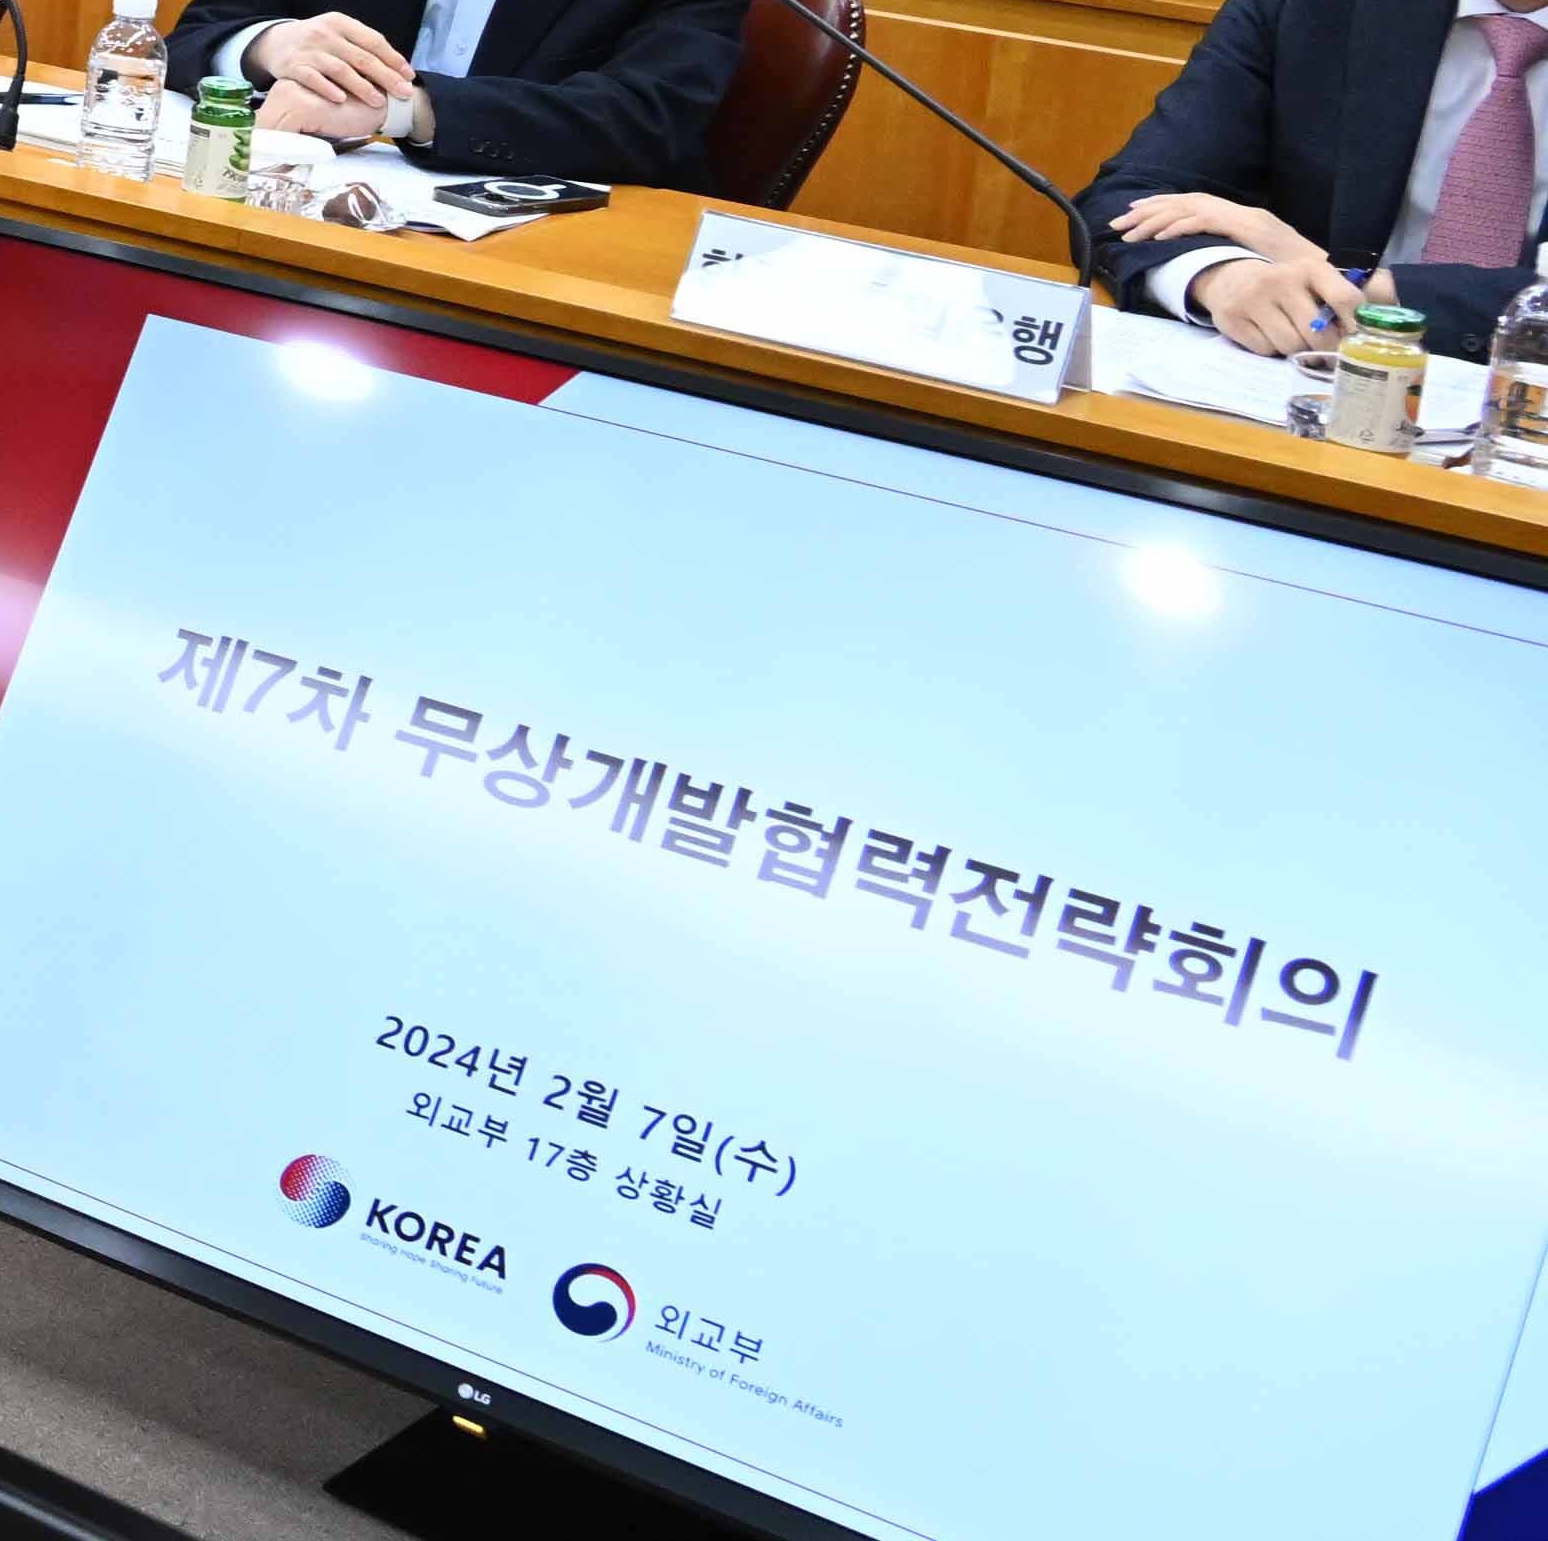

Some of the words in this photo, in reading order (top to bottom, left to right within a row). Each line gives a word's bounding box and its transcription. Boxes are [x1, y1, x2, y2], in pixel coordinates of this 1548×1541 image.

[158, 628, 373, 752] 제7차
[393, 695, 1380, 1063] 무상개발협력전략회의
[375, 1015, 529, 1098] 2024년
[543, 1074, 621, 1129] 2월
[640, 1105, 798, 1198] 7일(수)
[405, 1091, 510, 1149] 외교부
[525, 1136, 599, 1184] 17층
[615, 1165, 724, 1230] 상황실
[365, 1198, 506, 1280] KOREA
[646, 1340, 706, 1375] Ministry
[709, 1367, 727, 1381] of
[729, 1373, 789, 1405] Foreign
[792, 1399, 844, 1428] Affairs
[654, 1305, 764, 1364] 외교부
